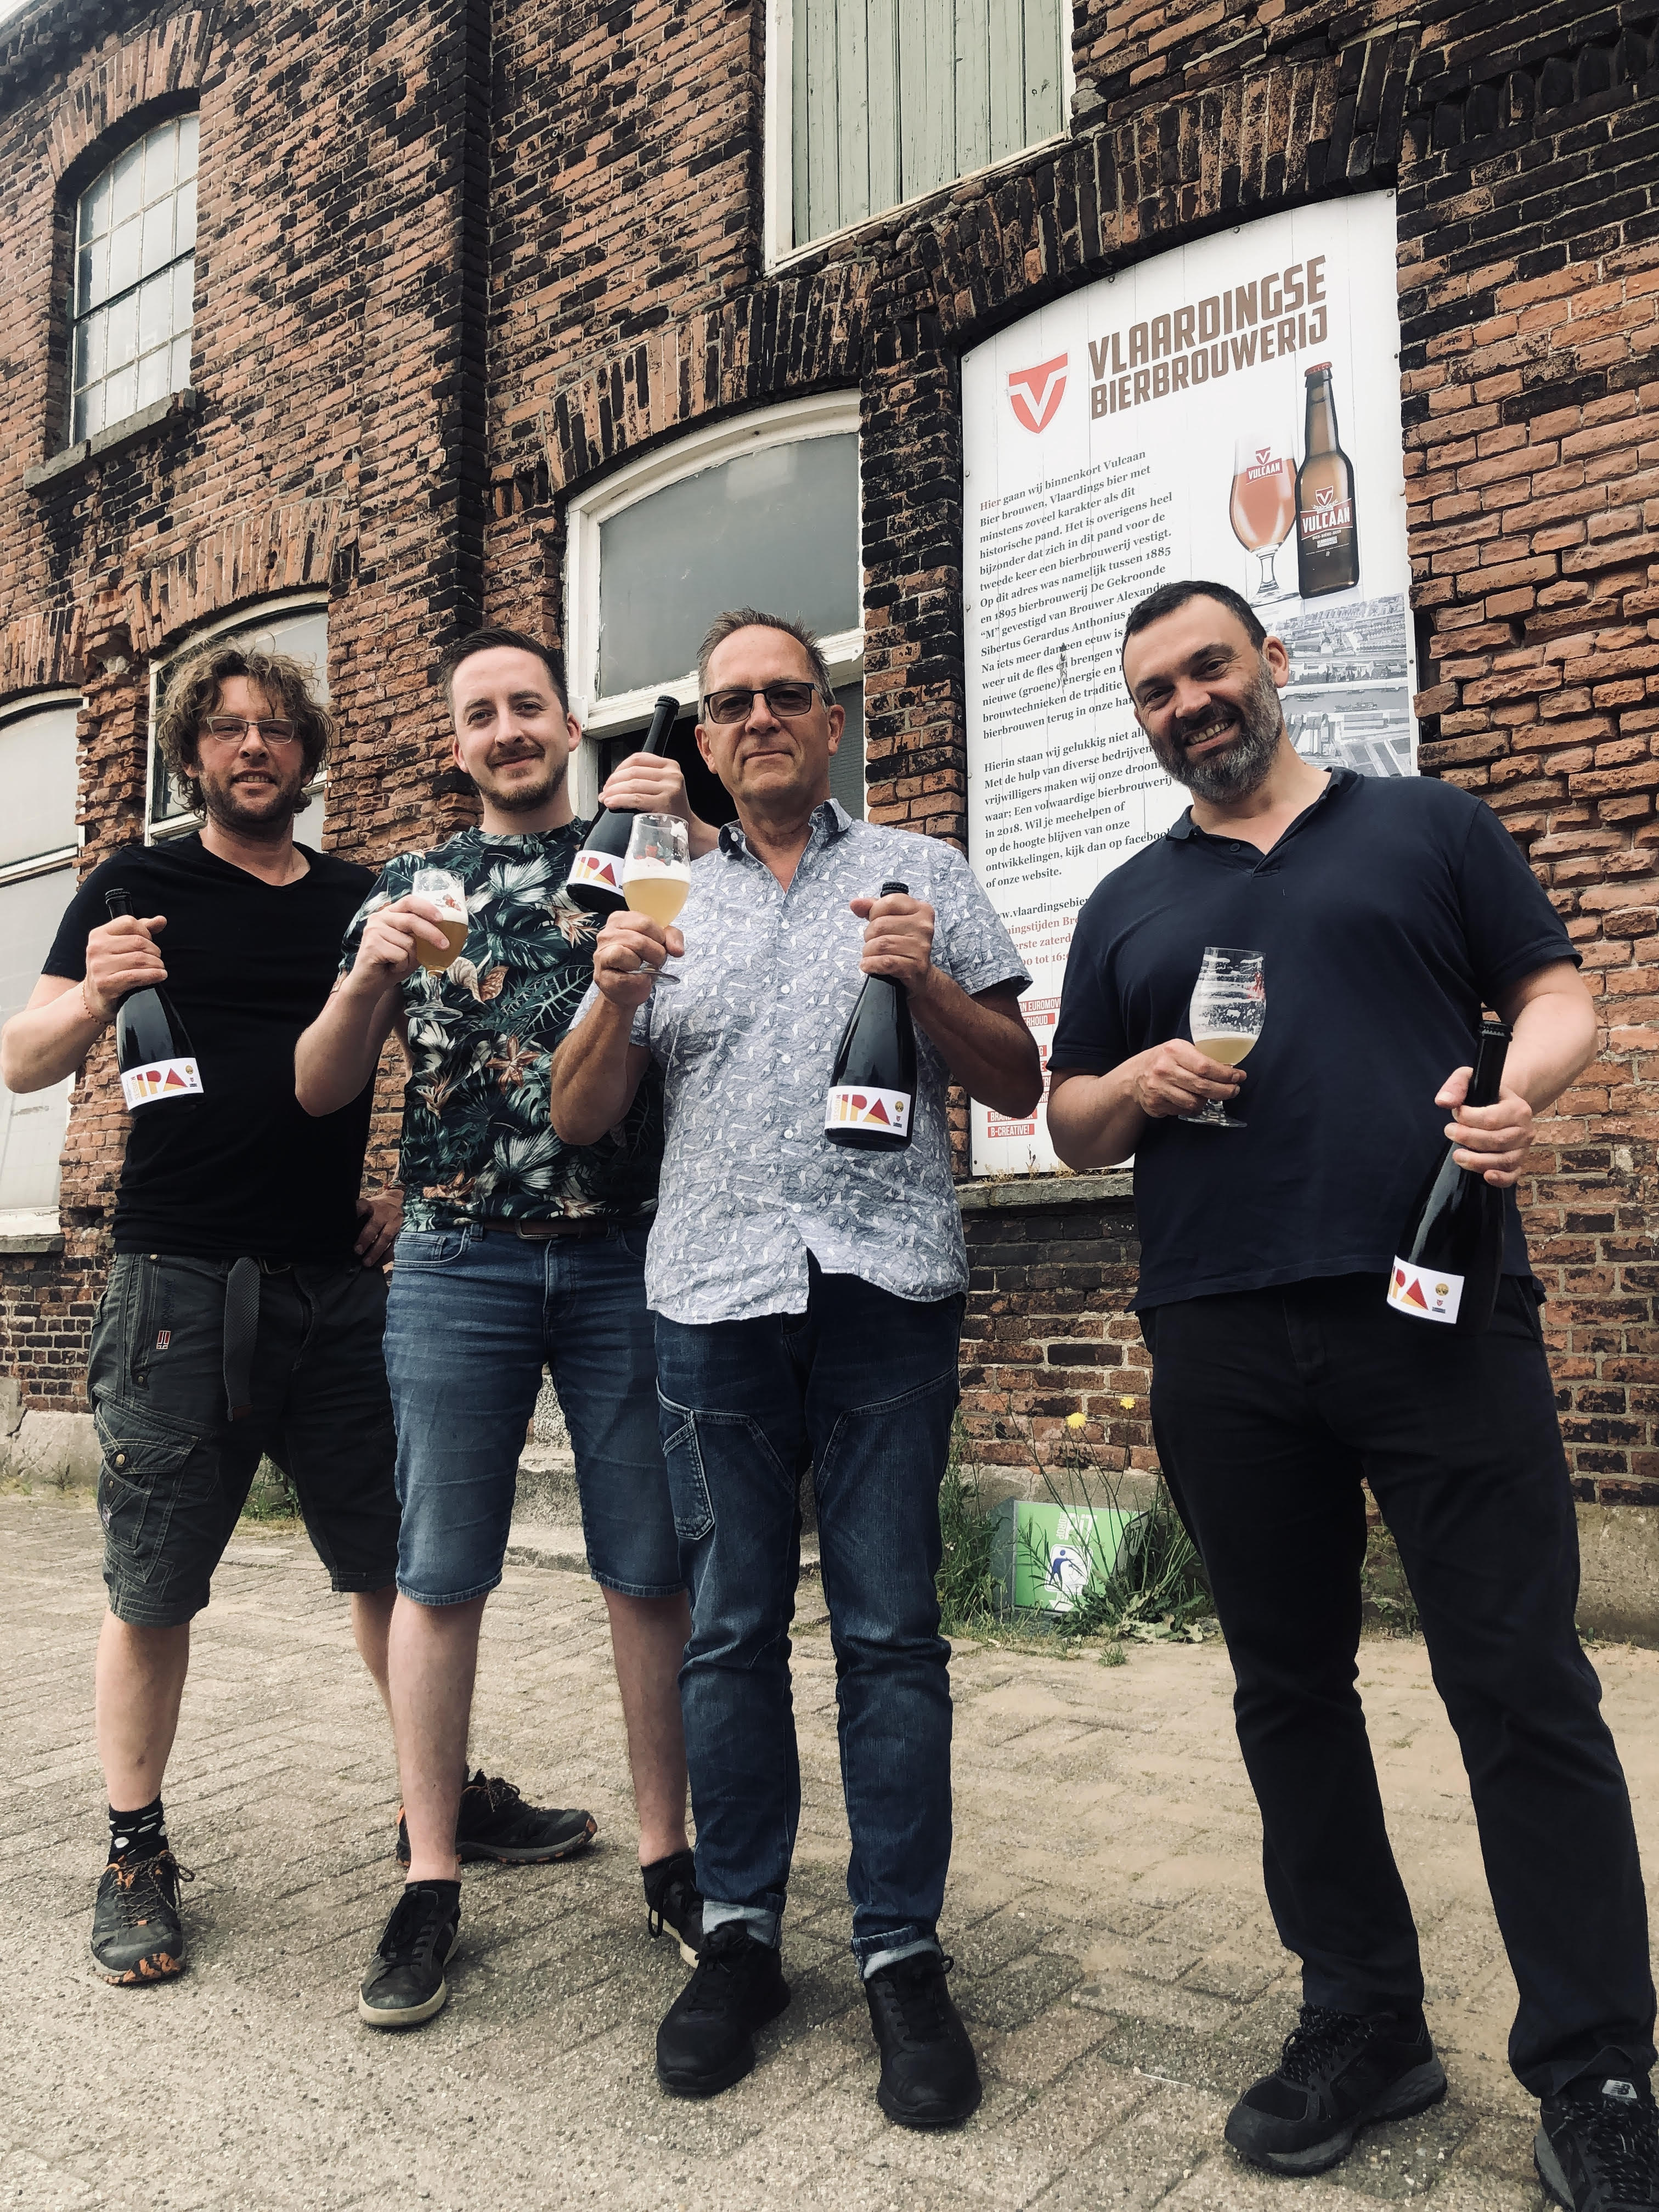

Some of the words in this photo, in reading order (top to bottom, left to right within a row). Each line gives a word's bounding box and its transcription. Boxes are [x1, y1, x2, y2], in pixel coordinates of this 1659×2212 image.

[1088, 255, 1327, 381] VLAARDINGSE
[1091, 304, 1328, 420] BIERBROUWERIJ
[980, 499, 1001, 511] Hier
[1002, 491, 1025, 506] gaan
[1028, 482, 1042, 495] wij
[1045, 465, 1101, 490] binnenkort
[1103, 452, 1146, 470] Vulcaan
[1248, 461, 1280, 479] VULCAAN
[979, 515, 1000, 527] Bier
[1001, 501, 1047, 520] brouwen,
[1049, 482, 1104, 504] Vlaardings
[1106, 474, 1127, 487] bier
[1130, 465, 1150, 479] met
[979, 524, 1023, 543] minstens
[1025, 511, 1055, 529] zoveel
[1058, 499, 1102, 518] karakter
[1103, 493, 1119, 504] als
[1120, 487, 1135, 499] dit
[979, 537, 1032, 560] historische
[1034, 526, 1062, 545] pand.
[1065, 520, 1083, 533] Het
[1085, 517, 1094, 527] is
[1097, 502, 1147, 523] overigens
[1149, 492, 1172, 507] heel
[1302, 507, 1350, 533] VULCAAN
[979, 556, 1025, 575] bijzonder
[1027, 549, 1043, 561] dat
[1045, 541, 1065, 556] zich
[1068, 539, 1077, 549] in
[1080, 533, 1094, 545] dit
[1097, 523, 1123, 543] pand
[1125, 518, 1150, 531] voor
[1152, 513, 1165, 523] de
[979, 575, 1013, 591] tweede
[1015, 569, 1037, 581] keer
[1039, 563, 1057, 574] een
[1059, 538, 1131, 568] bierbrouwerij
[1133, 529, 1171, 546] vestigt.
[980, 598, 994, 608] Op
[995, 592, 1009, 603] dit
[1011, 585, 1038, 599] adres
[1040, 579, 1059, 590] was
[1061, 563, 1106, 584] namelijk
[1108, 555, 1143, 571] tussen
[1145, 546, 1171, 560] 1885
[980, 616, 991, 624] en
[994, 608, 1016, 620] 1895
[1018, 585, 1087, 613] bierbrouwerij
[1091, 583, 1104, 593] De
[1106, 565, 1166, 588] Gekroonde
[980, 627, 1000, 639] “M”
[1001, 613, 1046, 637] gevestigd
[1048, 611, 1066, 621] van
[1069, 597, 1114, 616] Brouwer
[1116, 583, 1171, 603] Alexand
[980, 640, 1021, 657] Sibertus
[1023, 627, 1069, 645] Gerardus
[1071, 612, 1126, 633] Anthonius
[981, 663, 995, 674] Na
[996, 659, 1014, 669] iets
[1015, 651, 1041, 664] meer
[1084, 633, 1111, 645] eeuw
[1114, 628, 1123, 638] is
[981, 678, 1005, 690] weer
[1007, 672, 1021, 683] uit
[1023, 669, 1034, 679] de
[1036, 665, 1053, 675] fles
[1070, 650, 1114, 667] brengen
[982, 692, 1017, 706] nieuwe
[1018, 678, 1060, 698] (groene)
[1063, 669, 1101, 685] energie
[1103, 666, 1116, 675] en
[983, 696, 1067, 723] brouwtechnieken
[1069, 691, 1081, 701] de
[1083, 680, 1122, 698] traditie
[983, 718, 1045, 740] bierbrouwen
[1047, 711, 1074, 724] terug
[1076, 707, 1086, 716] in
[1088, 702, 1113, 713] onze
[984, 758, 1015, 772] Hierin
[1017, 753, 1043, 765] staan
[1045, 746, 1060, 758] wij
[1062, 736, 1106, 757] gelukkig
[1108, 731, 1129, 743] niet
[984, 777, 1003, 789] Met
[1005, 774, 1016, 785] de
[1018, 769, 1040, 781] hulp
[1042, 766, 1060, 775] van
[1062, 757, 1099, 771] diverse
[984, 787, 1042, 805] vrijwilligers
[1044, 779, 1077, 793] maken
[1080, 772, 1096, 785] wij
[1098, 769, 1123, 781] onze
[985, 810, 1012, 822] waar;
[1014, 806, 1032, 816] Een
[1034, 792, 1095, 811] volwaardige
[1098, 775, 1172, 798] bierbrouwerij
[985, 829, 995, 839] in
[996, 823, 1023, 836] 2018.
[1024, 818, 1042, 830] Wil
[1043, 817, 1053, 829] je
[1055, 807, 1111, 824] meehelpen
[1113, 800, 1125, 812] of
[985, 847, 997, 856] op
[999, 842, 1011, 853] de
[1012, 837, 1046, 850] hoogte
[1047, 830, 1082, 843] blijven
[1084, 826, 1102, 836] van
[1105, 821, 1130, 831] onze
[575, 857, 617, 887] IPA
[985, 851, 1063, 872] ontwikkelingen,
[1065, 844, 1084, 857] kijk
[1086, 842, 1107, 852] dan
[1108, 840, 1122, 850] op
[986, 877, 996, 888] of
[997, 876, 1020, 886] onze
[1022, 867, 1062, 882] website.
[1035, 955, 1049, 964] tot
[137, 1068, 188, 1098] IPA
[839, 1094, 891, 1126] IPA
[991, 1125, 1030, 1137] B-CREATIVE!
[1056, 1519, 1067, 1539] DROP
